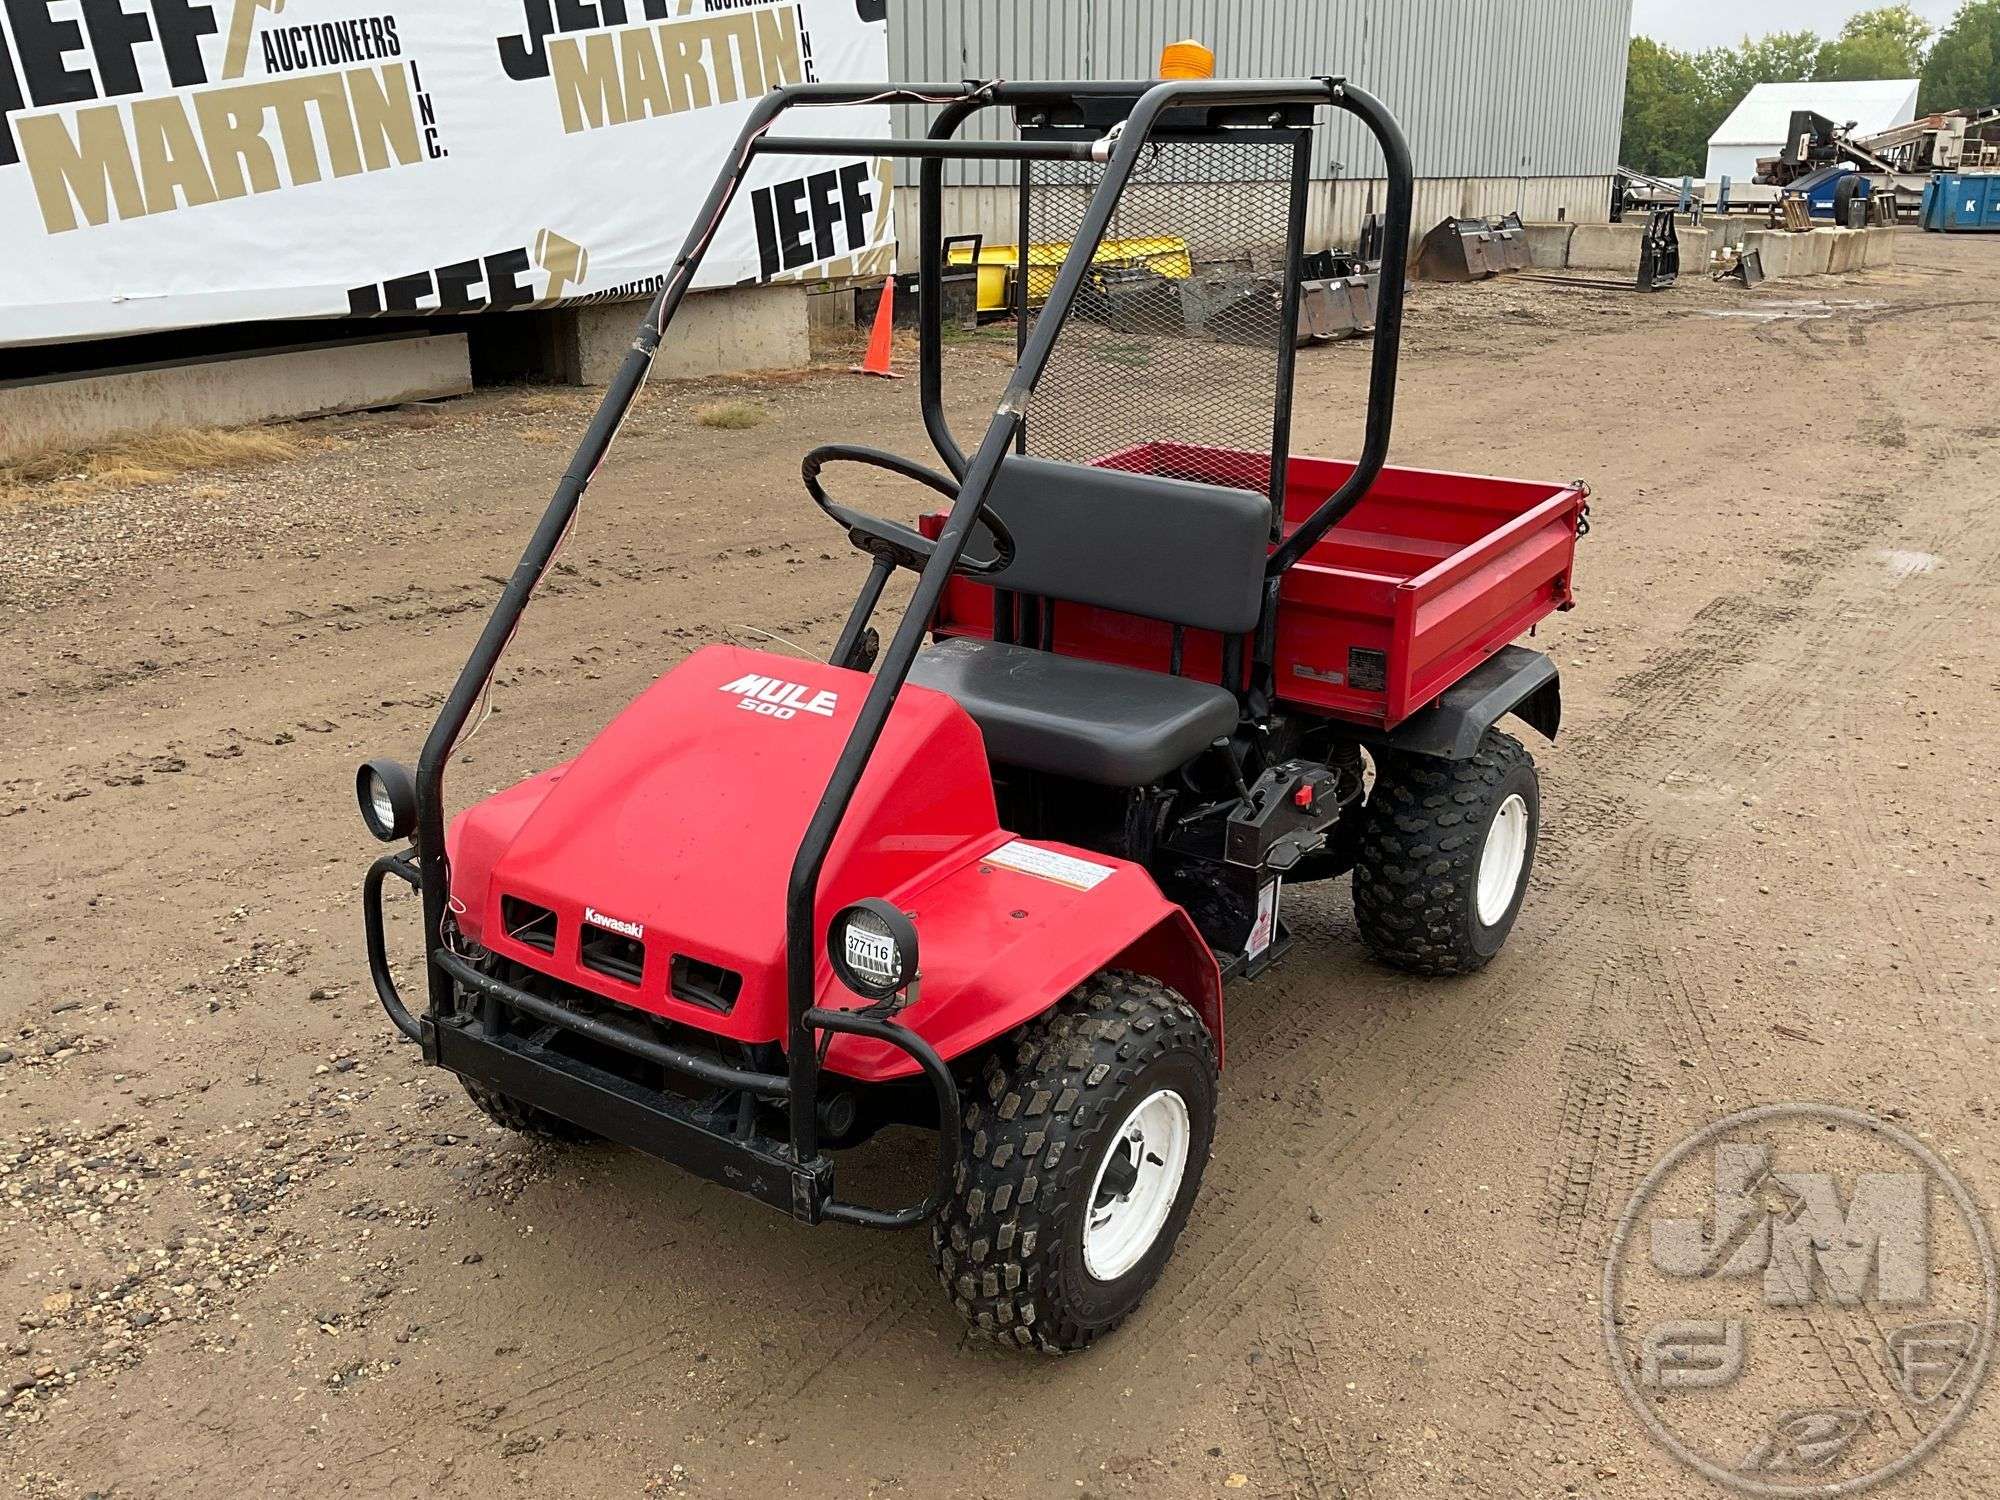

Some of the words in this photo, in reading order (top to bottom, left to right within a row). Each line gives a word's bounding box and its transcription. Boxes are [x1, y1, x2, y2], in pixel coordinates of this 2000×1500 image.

[0, 0, 218, 167] EFF
[260, 14, 402, 75] AUCTIONEERS
[548, 5, 803, 135] MARTIN
[15, 63, 423, 236] MARTIN
[409, 60, 449, 159] INC.
[748, 161, 874, 284] JEFF
[718, 673, 839, 717] MULE
[736, 697, 797, 720] 500
[584, 906, 644, 939] Kawasaki
[847, 934, 889, 961] 377116
